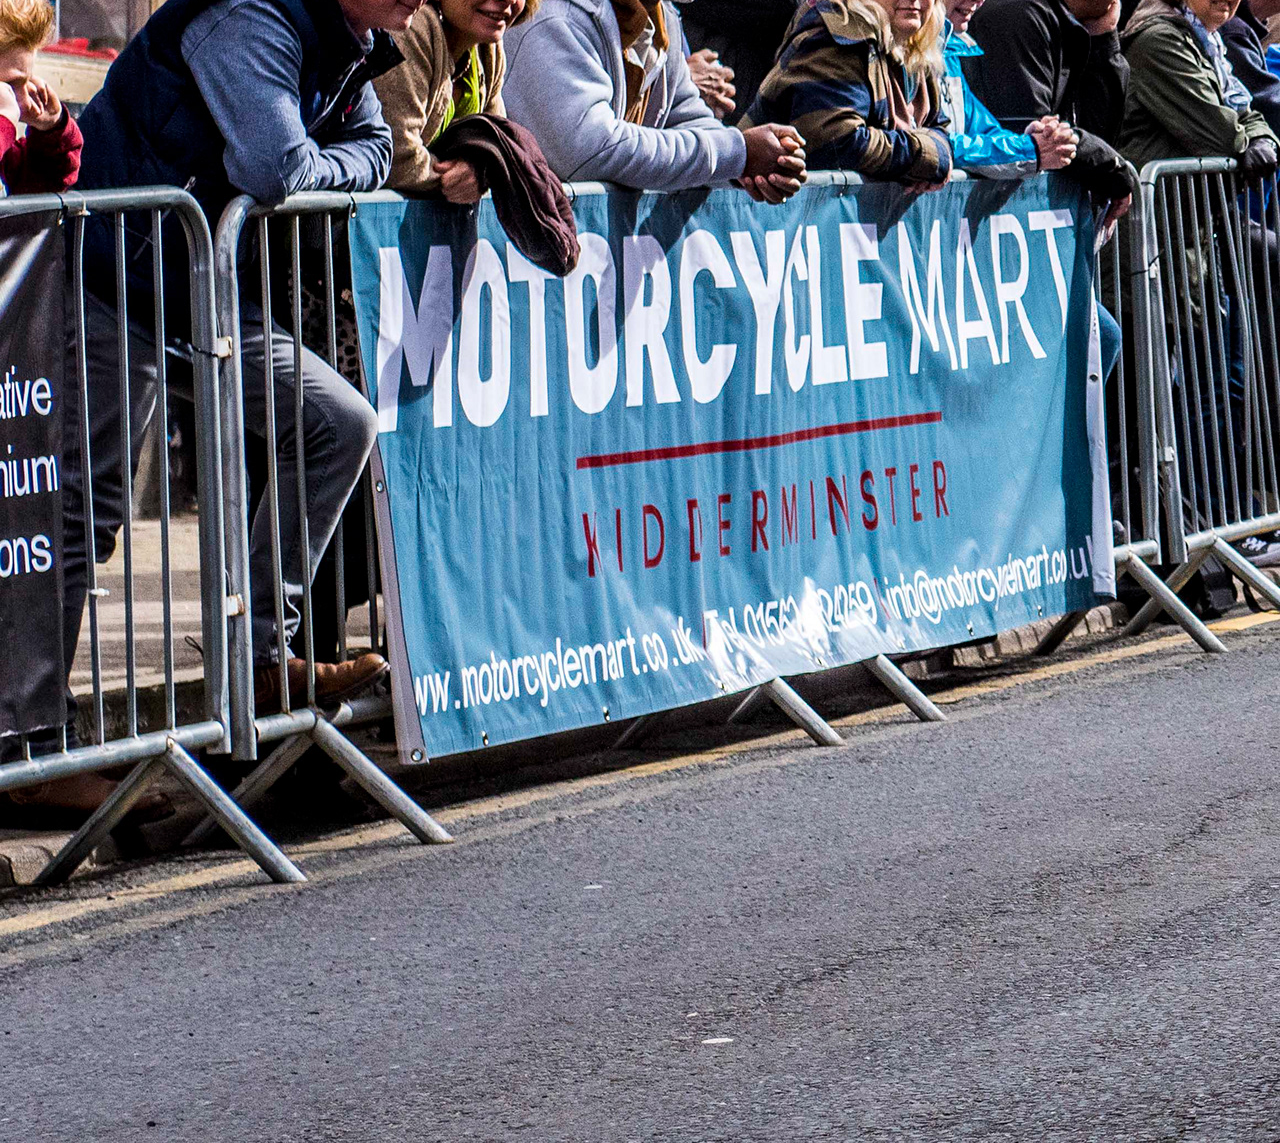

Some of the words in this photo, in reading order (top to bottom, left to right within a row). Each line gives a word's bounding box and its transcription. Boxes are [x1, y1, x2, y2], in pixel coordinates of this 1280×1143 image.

[378, 220, 889, 433] MOTORCYCLE
[898, 209, 1075, 375] MART
[582, 459, 951, 578] KIDDERMINSTER
